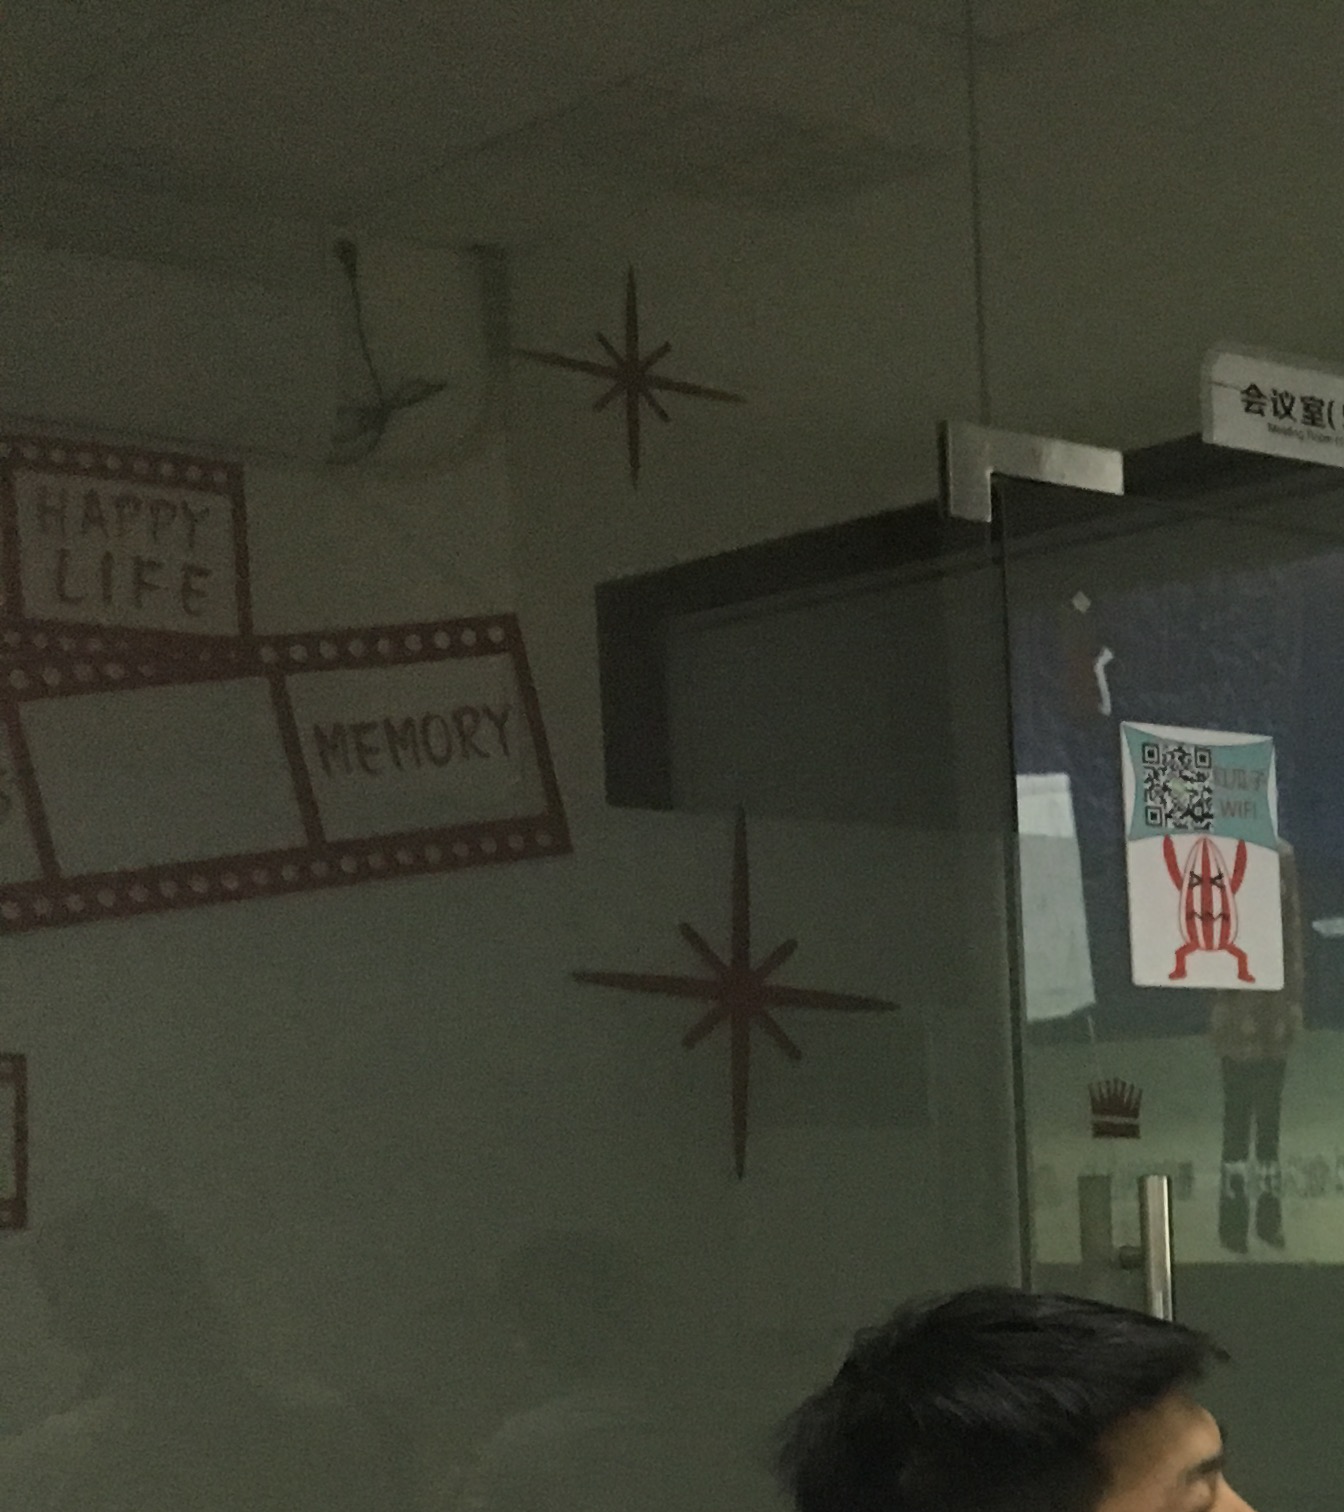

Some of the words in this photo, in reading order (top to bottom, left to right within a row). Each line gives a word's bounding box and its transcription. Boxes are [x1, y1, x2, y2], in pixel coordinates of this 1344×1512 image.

[36, 488, 211, 550] HAPPY
[55, 547, 213, 617] LIFE
[312, 703, 514, 780] MEMORY
